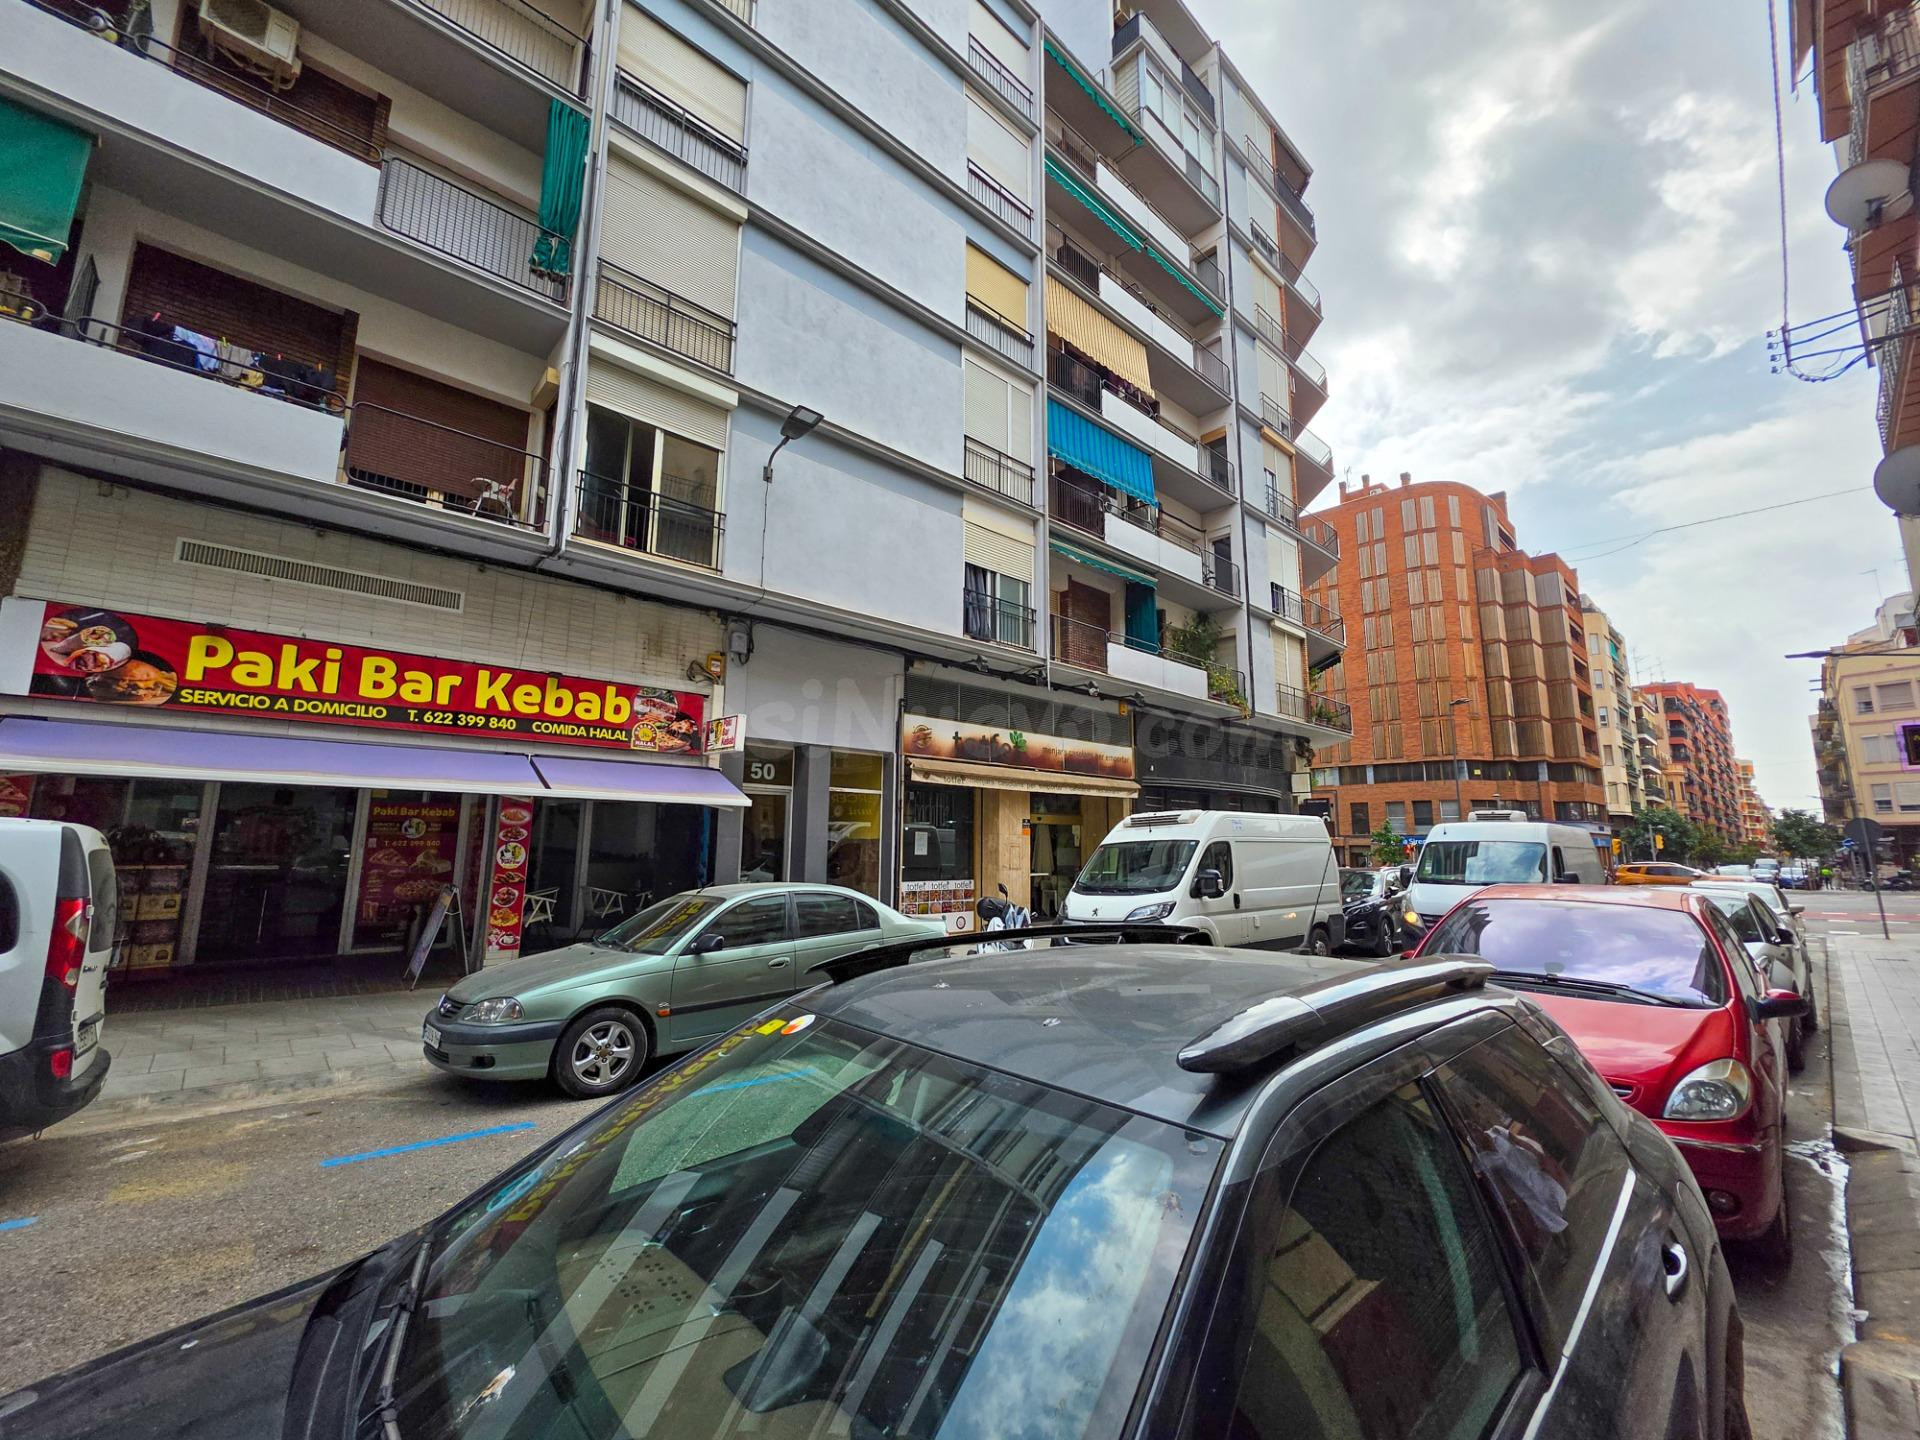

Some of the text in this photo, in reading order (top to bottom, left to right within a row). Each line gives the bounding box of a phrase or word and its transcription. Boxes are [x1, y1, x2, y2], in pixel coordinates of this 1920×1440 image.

[185, 635, 631, 723] Paki Bar Kebab
[180, 689, 629, 741] SERVICIO A DOMICILIO T. 622 399 840 COMIDA HALAL
[750, 762, 776, 779] 50
[373, 807, 456, 817] Paki Bar Kebab
